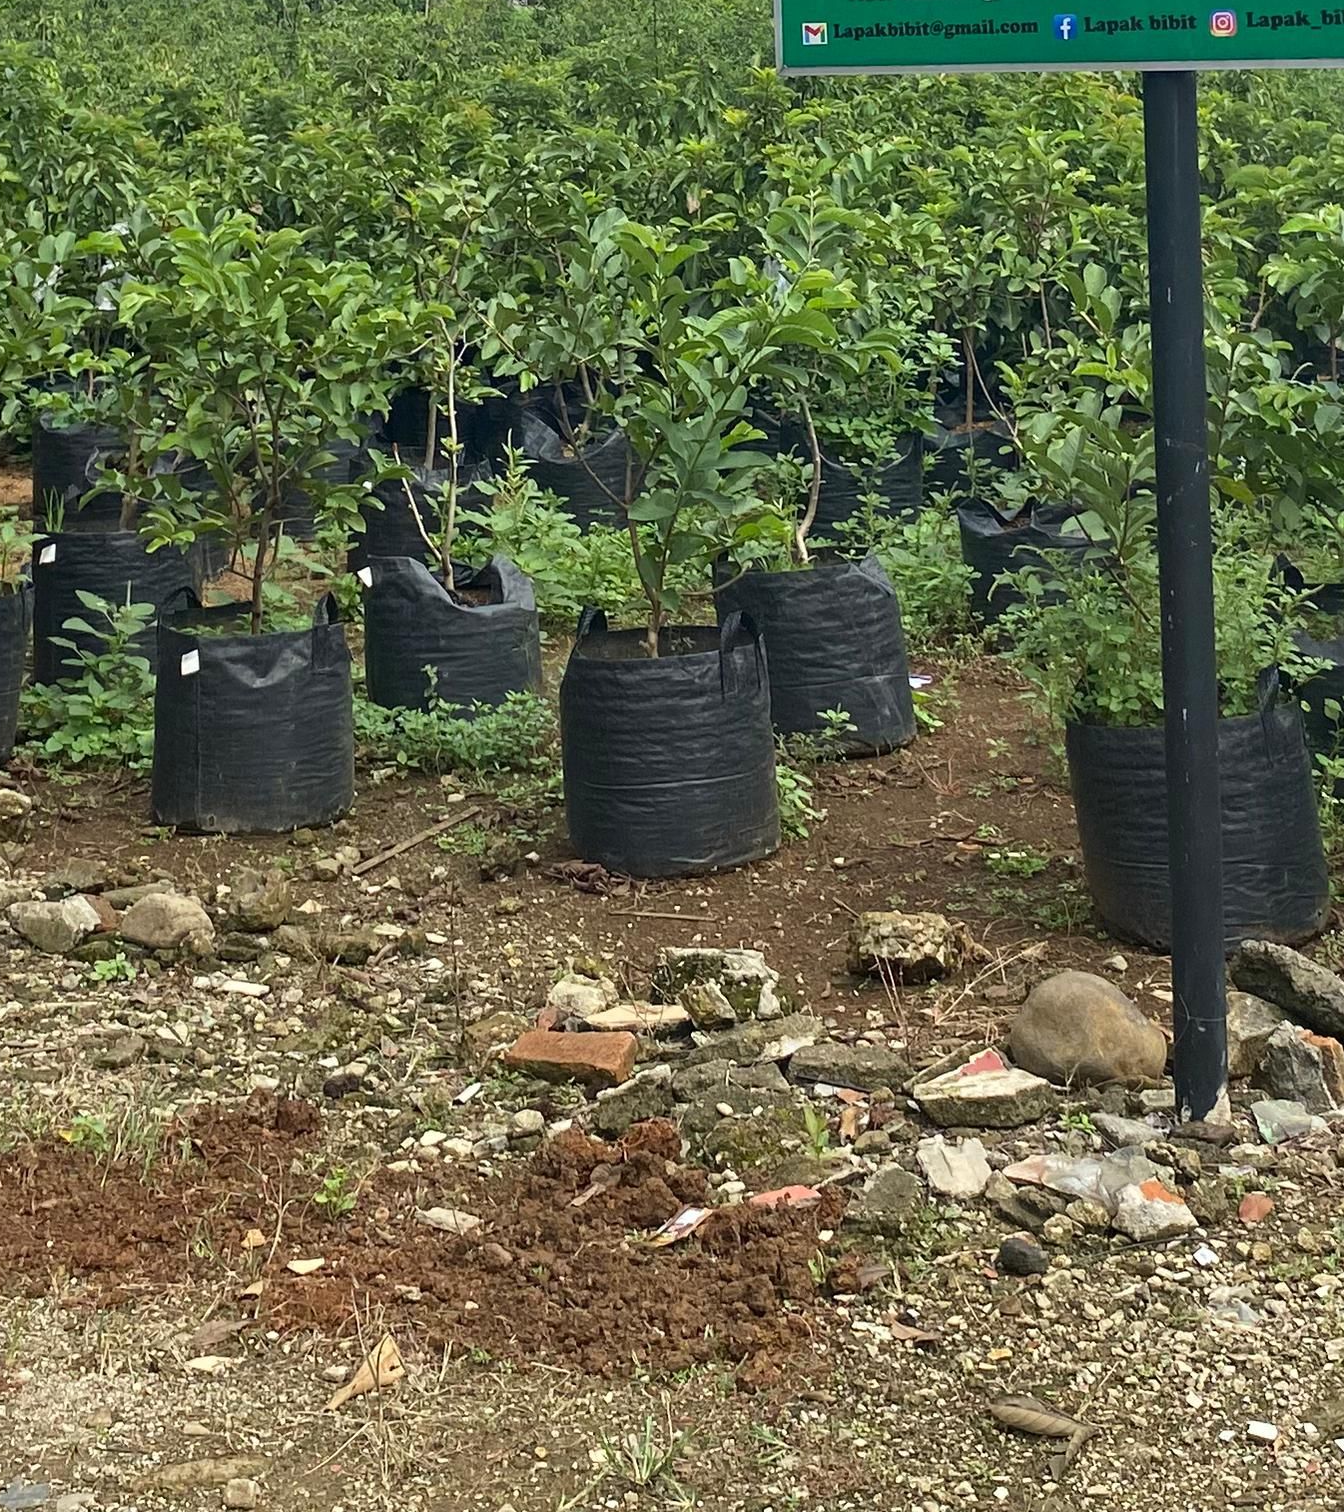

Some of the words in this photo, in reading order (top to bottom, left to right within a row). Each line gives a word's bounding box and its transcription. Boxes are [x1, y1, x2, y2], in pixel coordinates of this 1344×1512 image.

[833, 20, 1038, 40] Lapakbibit@gmail.com
[1084, 16, 1144, 35] Lapak
[1149, 14, 1197, 31] bibit
